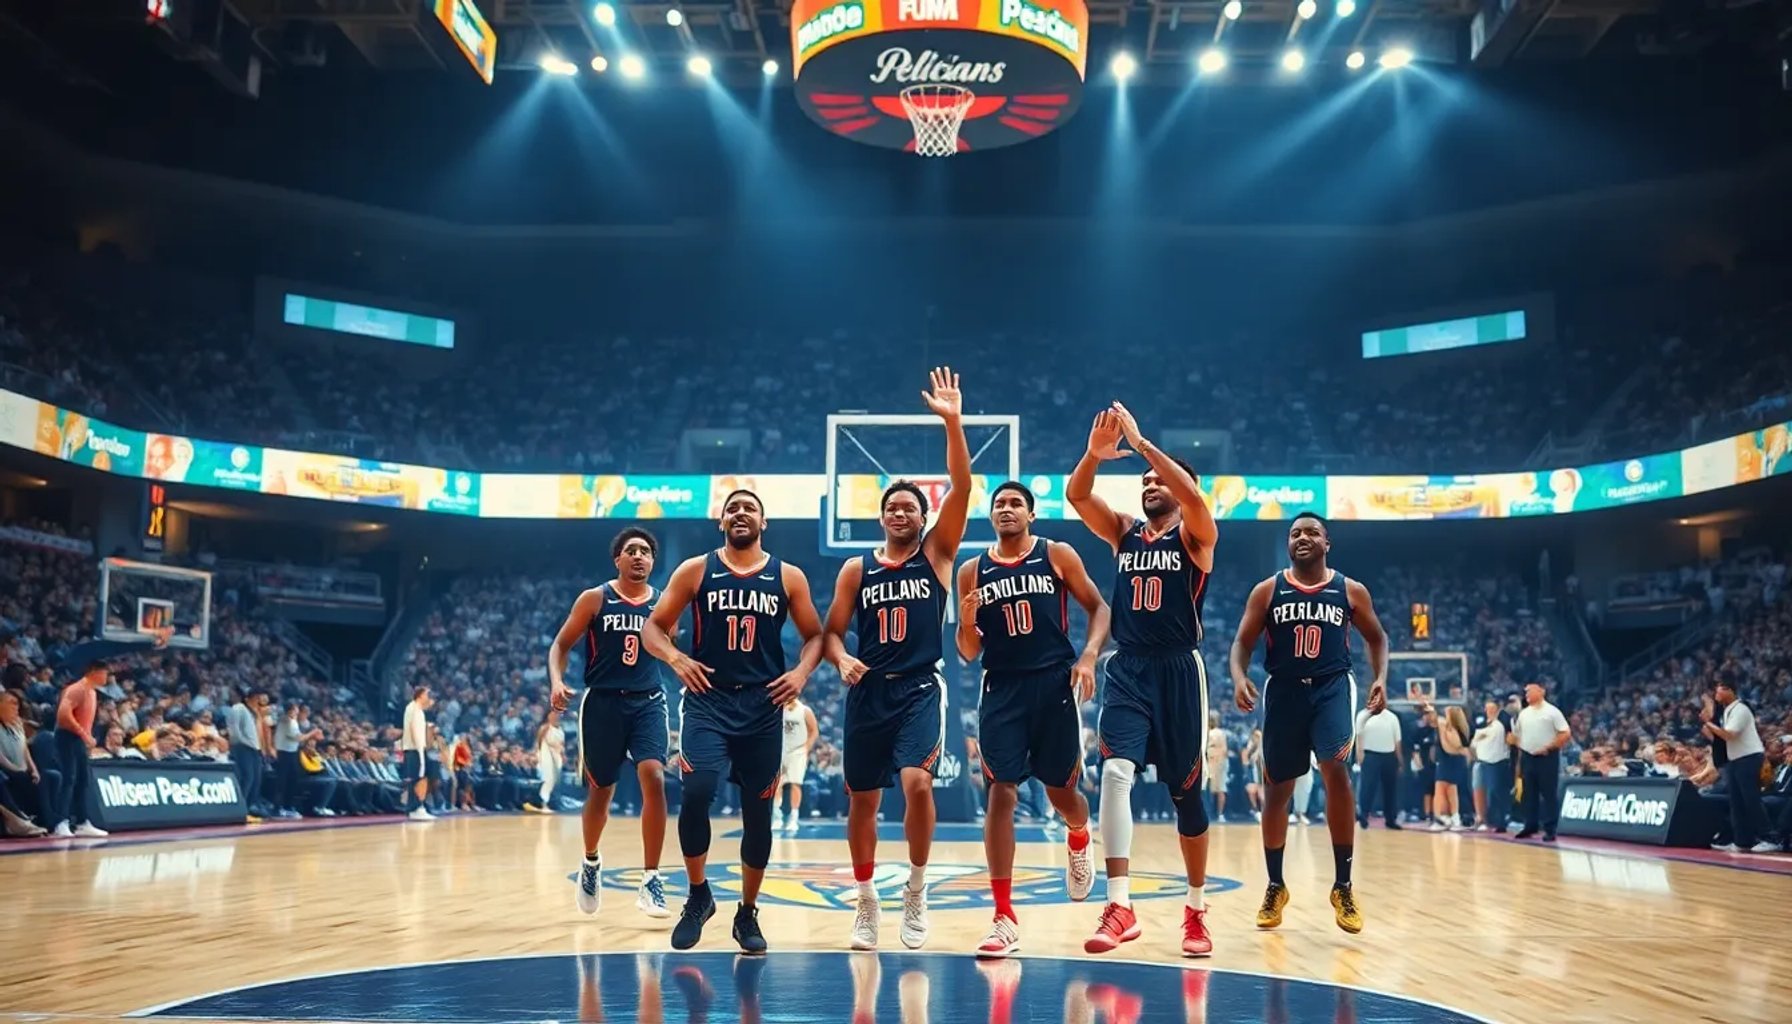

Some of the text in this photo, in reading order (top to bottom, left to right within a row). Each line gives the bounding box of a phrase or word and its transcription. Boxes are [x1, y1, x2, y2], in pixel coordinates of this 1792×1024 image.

[707, 589, 779, 617] PELLANS
[1131, 576, 1162, 612] 10
[878, 606, 907, 644] 10
[1002, 599, 1033, 637] 10
[1293, 624, 1322, 659] 10
